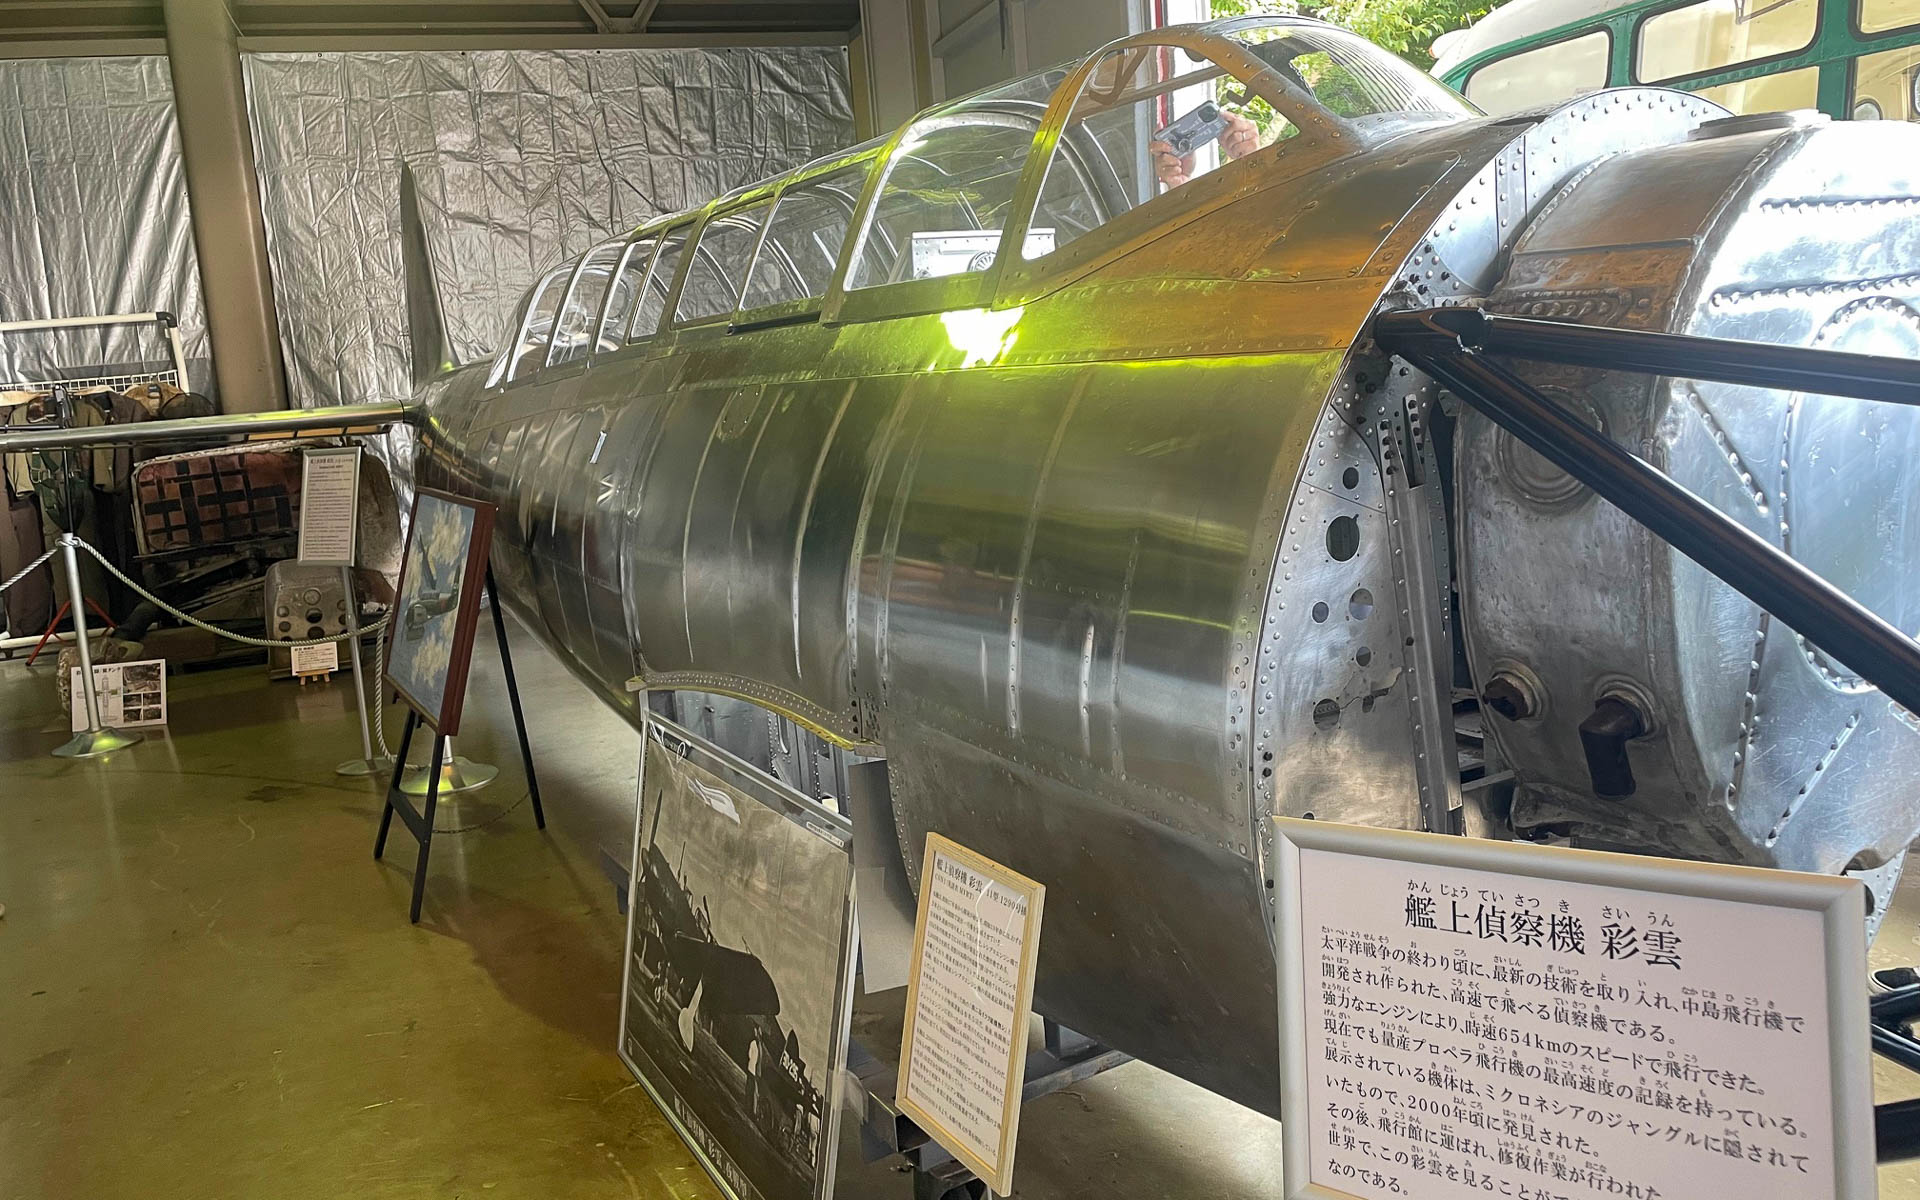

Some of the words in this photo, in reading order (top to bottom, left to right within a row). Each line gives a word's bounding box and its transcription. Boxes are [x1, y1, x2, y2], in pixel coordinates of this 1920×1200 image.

[1405, 893, 1586, 955] 艦上偵察機
[1601, 923, 1681, 970] 彩雲
[1408, 880, 1431, 892] かん
[1441, 885, 1468, 898] じょう
[1479, 890, 1503, 901] てい
[1515, 894, 1540, 908] さつ
[1559, 900, 1569, 913] き
[1602, 906, 1630, 919] さい
[1648, 912, 1674, 927] うん
[1321, 935, 1805, 1034] 太平洋戦争の終わり頃に、最新の技術を取り入れ、中島飛行機で
[1322, 962, 1675, 1045] 開発され作られた、高速で飛べる偵察機である。
[1323, 991, 1765, 1096] 強力なエンジンにより、時速654kmのスピードで飛行できた。
[1324, 1018, 1807, 1139] 現在でも量産プロペラ飛行機の最高速度の記録を持っている。
[1325, 1046, 1809, 1173] 展示されている機体は、ミクロネシアのジャングルに隠されて
[1326, 1074, 1599, 1158] いたもので、2000年頃に発見された。
[1328, 1158, 1408, 1196] なのである。
